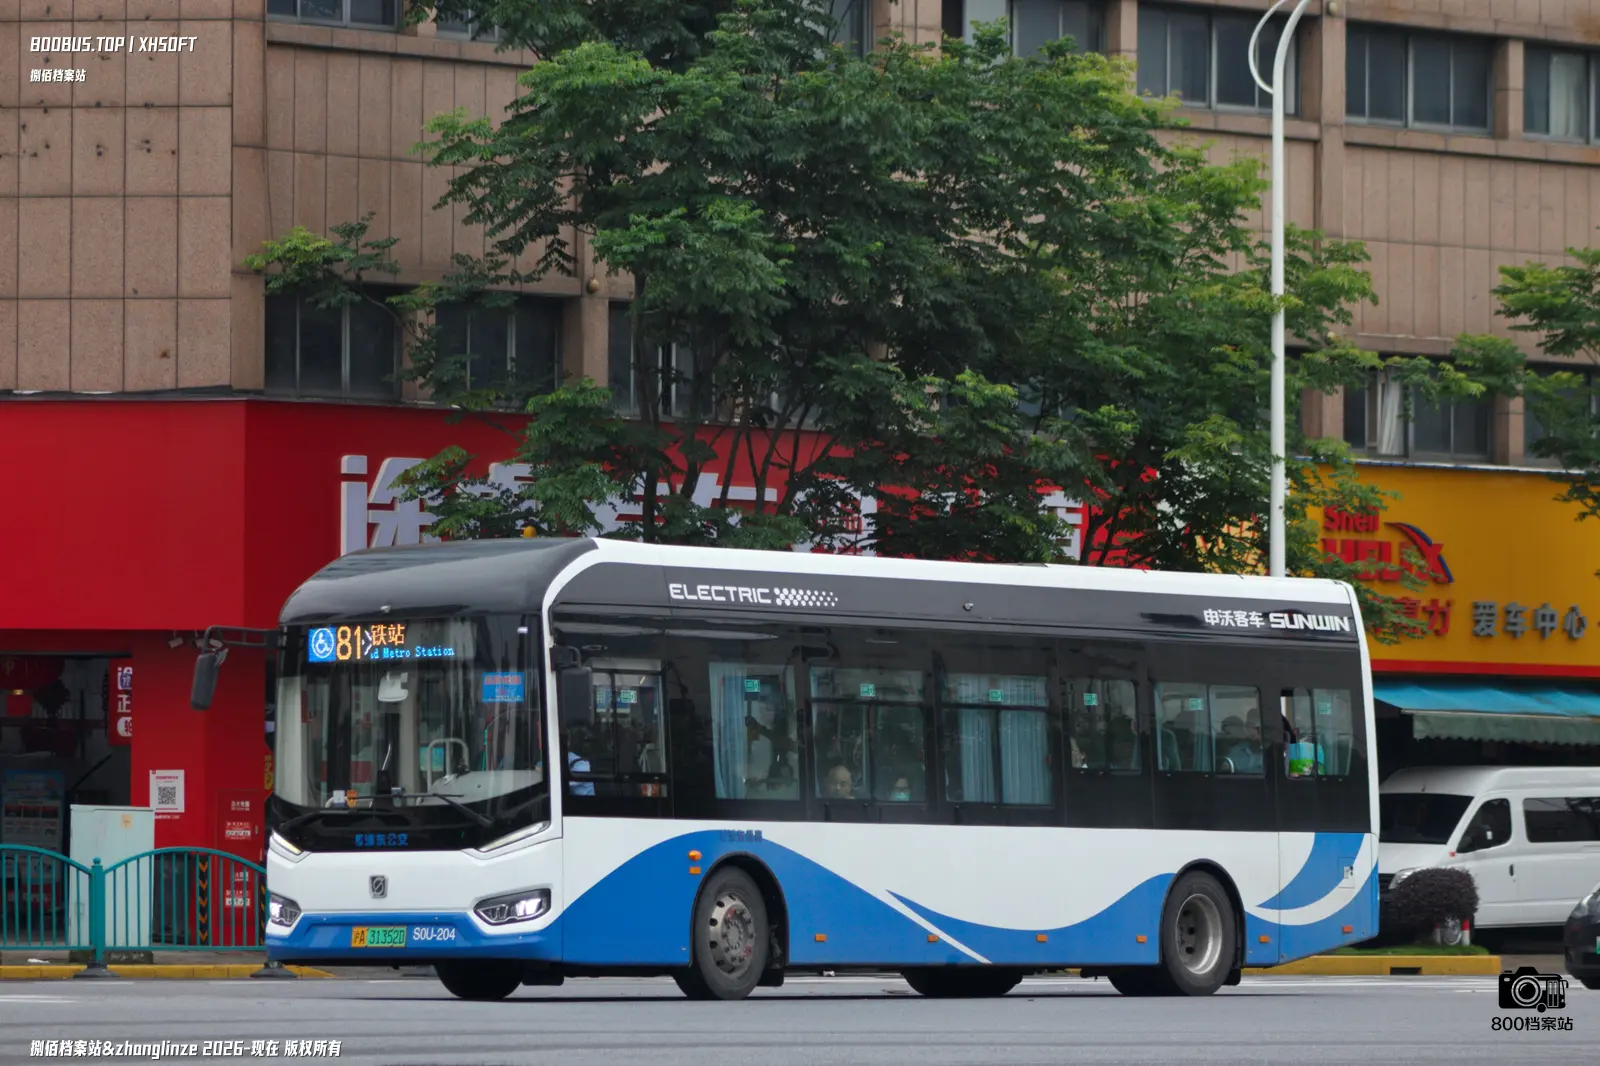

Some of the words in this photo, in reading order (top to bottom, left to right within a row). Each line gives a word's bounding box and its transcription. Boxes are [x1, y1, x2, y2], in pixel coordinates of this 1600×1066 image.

[668, 583, 772, 604] ELECTRIC
[1203, 608, 1265, 629] 申沃客车
[1268, 612, 1351, 632] SUNWIN
[1472, 600, 1587, 640] 爱车中心
[336, 625, 362, 661] 81
[370, 623, 406, 646] 铁站
[383, 647, 411, 659] Metro
[415, 645, 455, 658] Station
